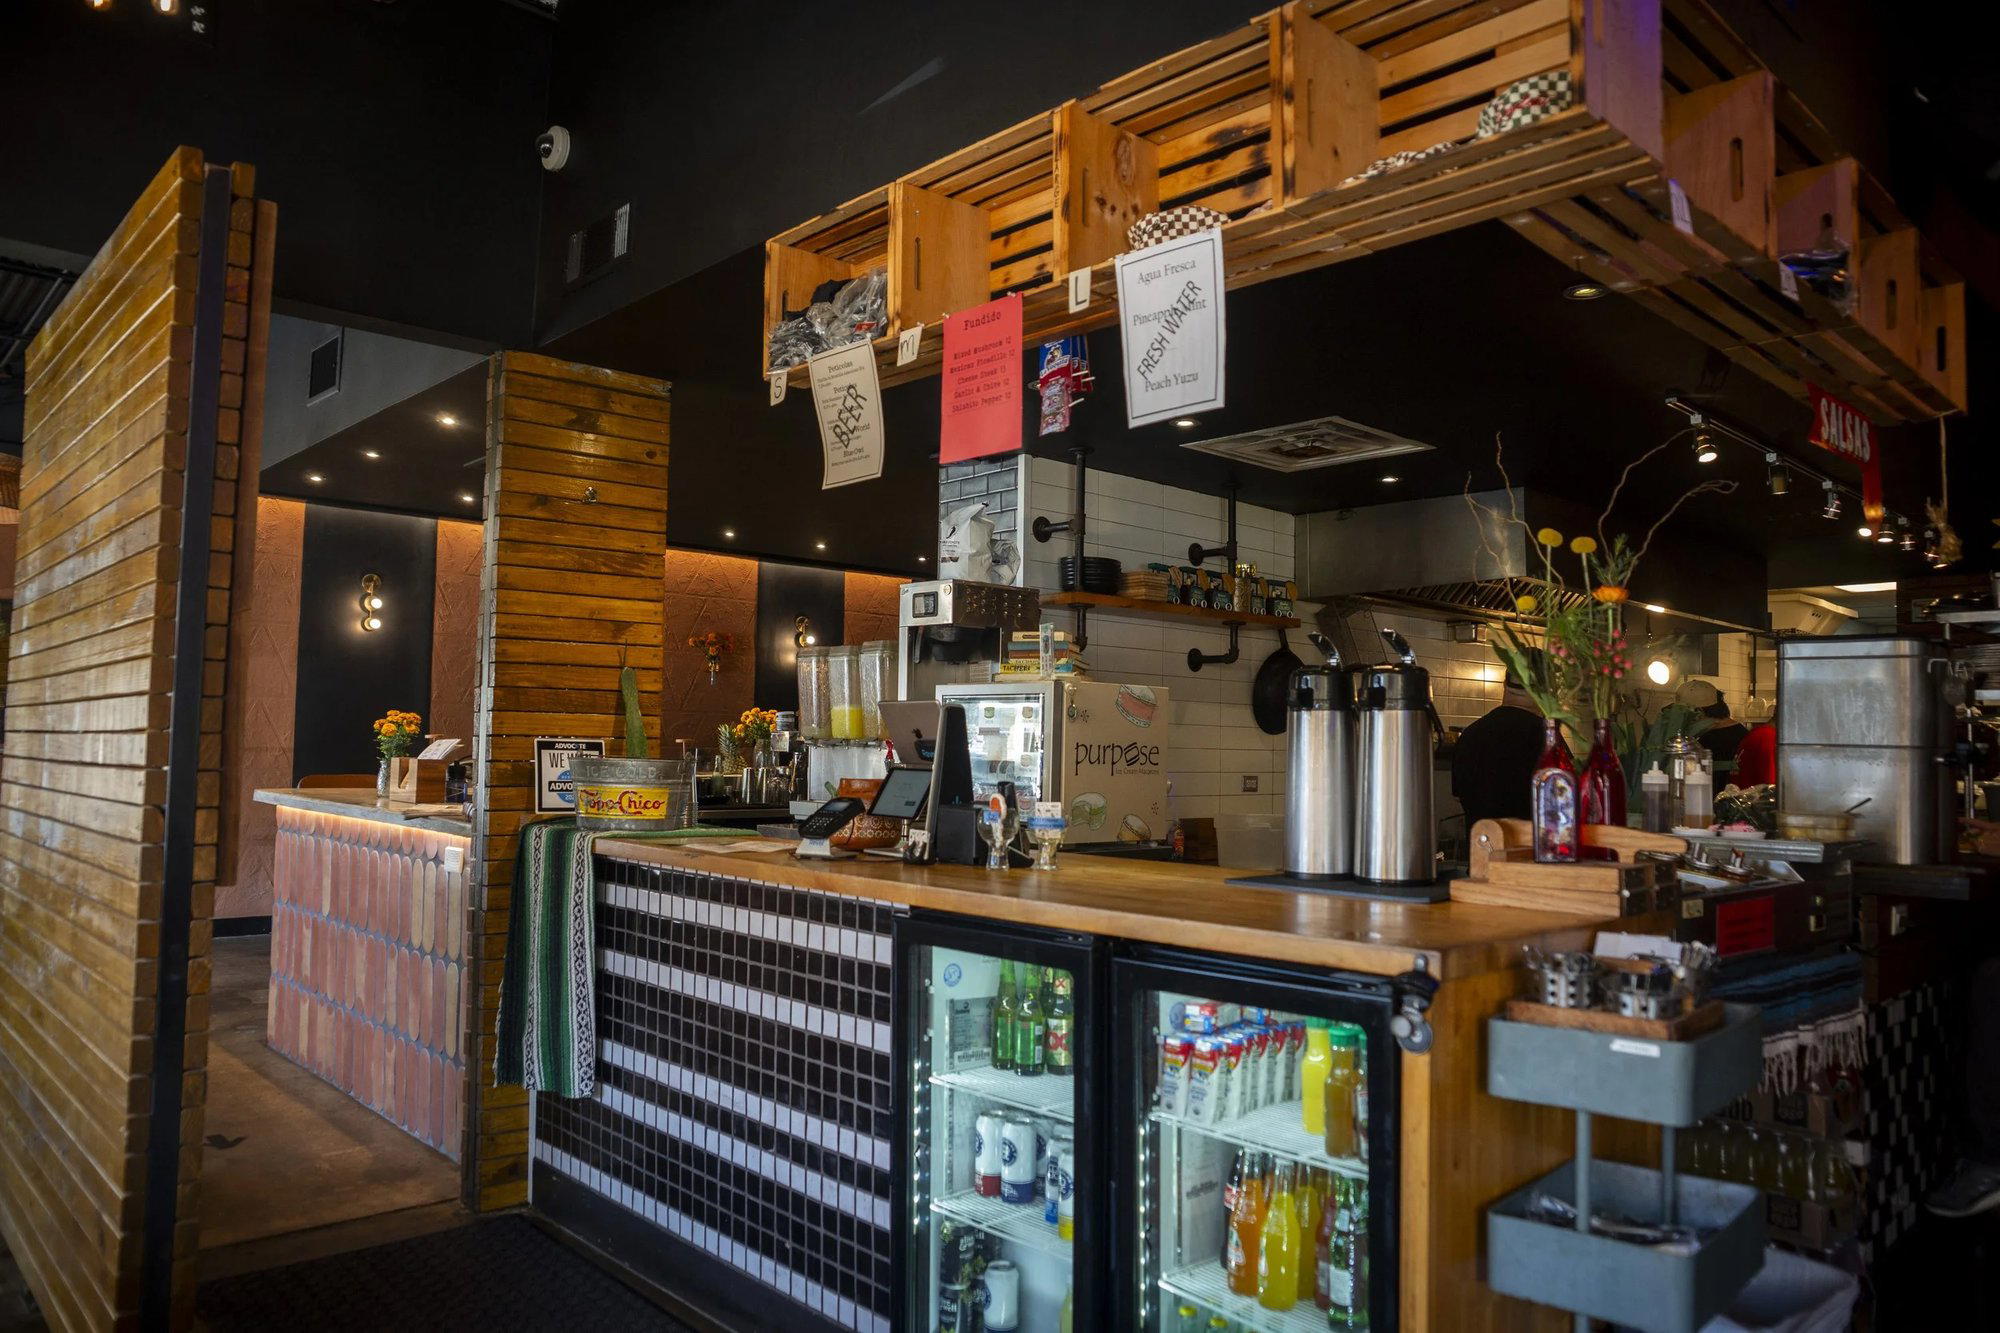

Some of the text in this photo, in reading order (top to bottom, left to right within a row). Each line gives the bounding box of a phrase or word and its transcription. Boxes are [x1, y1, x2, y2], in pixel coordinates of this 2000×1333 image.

[1137, 259, 1197, 286] Agua Fresca
[1075, 274, 1088, 306] L
[963, 310, 1002, 331] Fundido
[1133, 302, 1178, 327] Pineapp
[1136, 279, 1203, 382] FRESH WATER
[774, 377, 783, 399] S
[1144, 371, 1200, 393] Peach Yuzu
[832, 384, 868, 449] BEER
[1820, 397, 1871, 464] SALSAS
[549, 752, 565, 769] WE
[1074, 741, 1160, 776] purpose
[585, 765, 658, 779] ICE COLD
[618, 790, 666, 816] Chico
